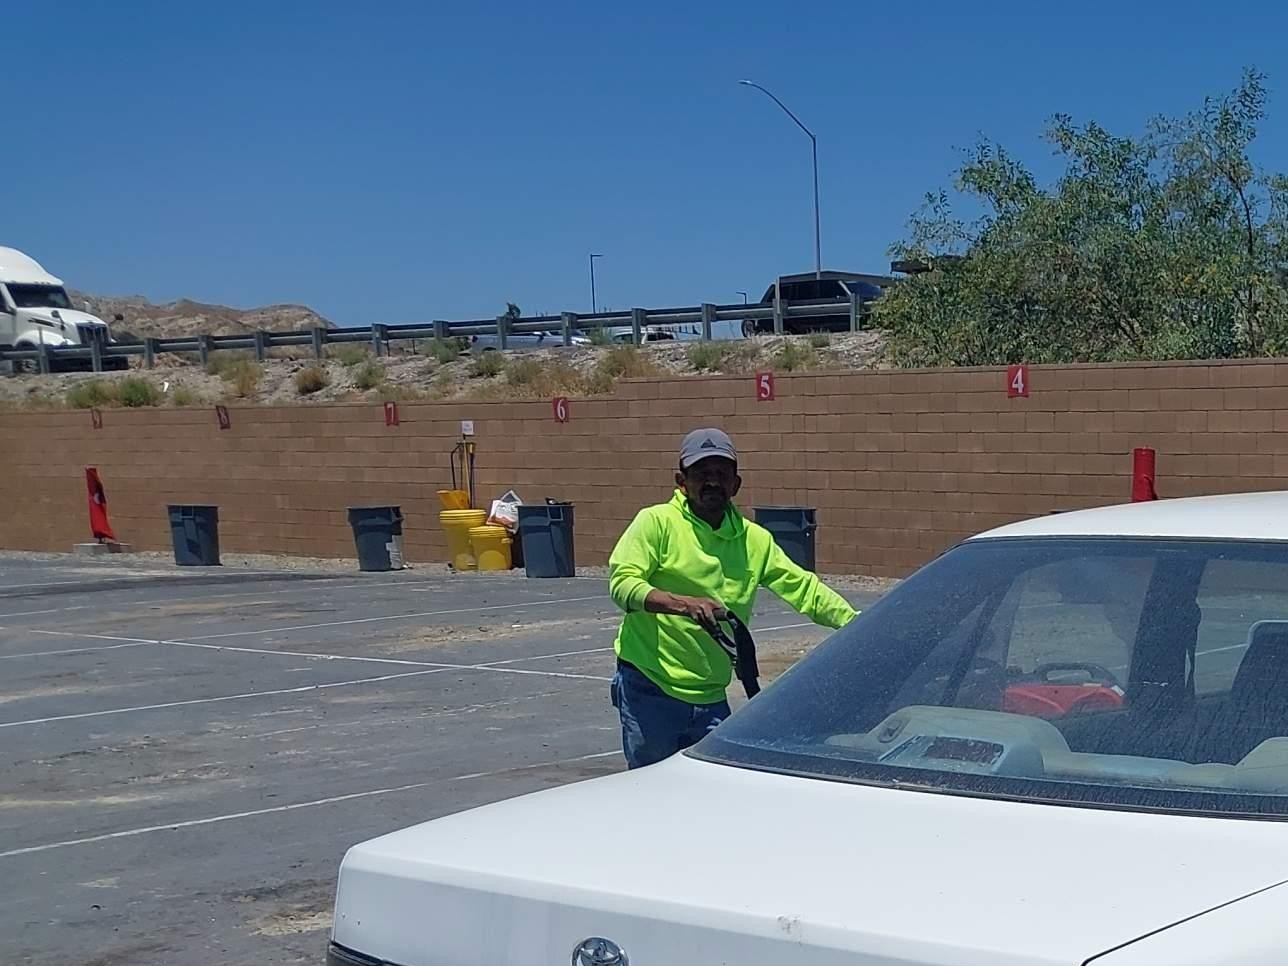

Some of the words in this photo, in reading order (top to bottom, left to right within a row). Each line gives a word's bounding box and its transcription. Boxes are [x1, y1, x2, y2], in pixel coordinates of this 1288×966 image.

[760, 374, 771, 399] 5
[1012, 367, 1025, 394] 4
[386, 402, 395, 422] 7
[556, 398, 566, 421] 6
